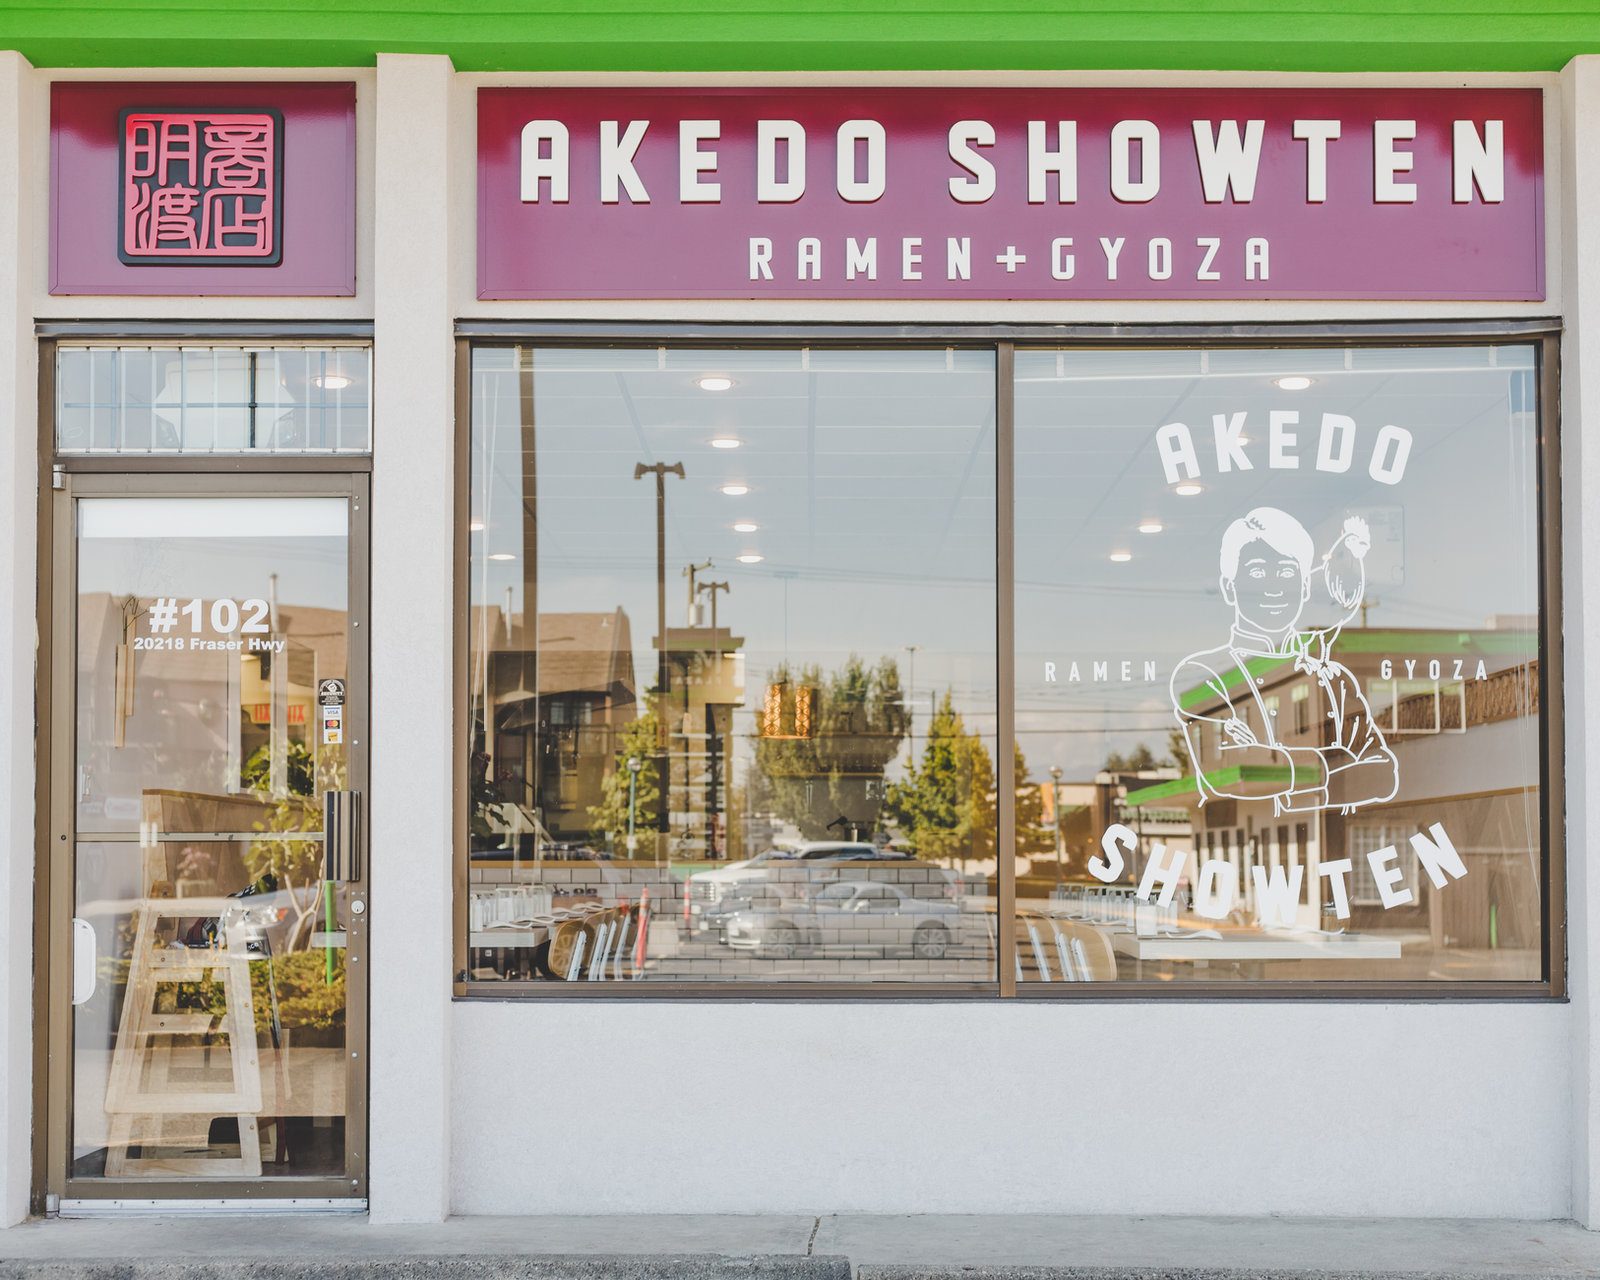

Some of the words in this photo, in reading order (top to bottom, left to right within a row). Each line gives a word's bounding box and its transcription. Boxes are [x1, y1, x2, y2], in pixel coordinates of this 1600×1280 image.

[519, 119, 887, 204] AKEDO
[948, 119, 1506, 205] SHOWTEN
[1155, 410, 1413, 485] AKEDO
[149, 598, 270, 634] #102
[134, 637, 185, 651] 20218
[189, 637, 244, 651] Fraser
[248, 637, 285, 653] Hwy
[1044, 660, 1157, 683] RAMEN
[1380, 659, 1488, 682] GYOZA
[1087, 821, 1468, 926] SHOWTEN
